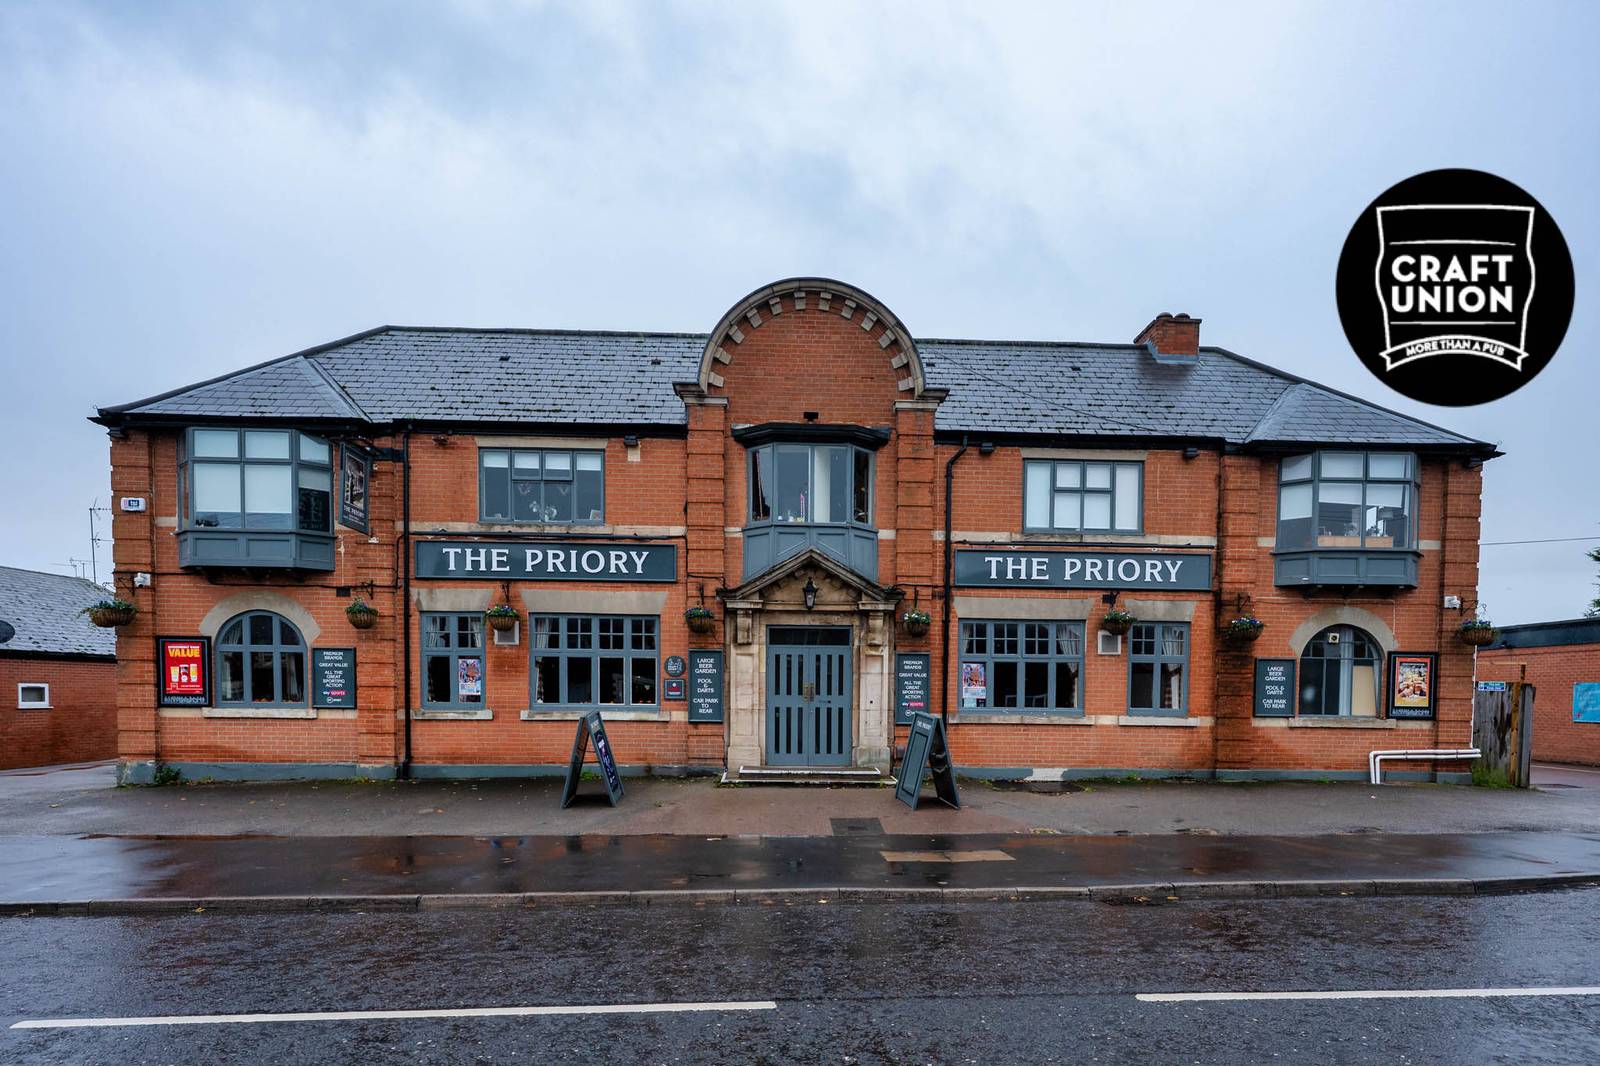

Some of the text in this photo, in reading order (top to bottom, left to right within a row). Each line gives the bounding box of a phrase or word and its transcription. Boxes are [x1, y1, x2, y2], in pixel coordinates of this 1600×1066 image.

[442, 547, 650, 575] THE PRIORY
[984, 556, 1184, 583] THE PRIORY
[168, 648, 200, 658] VALUE
